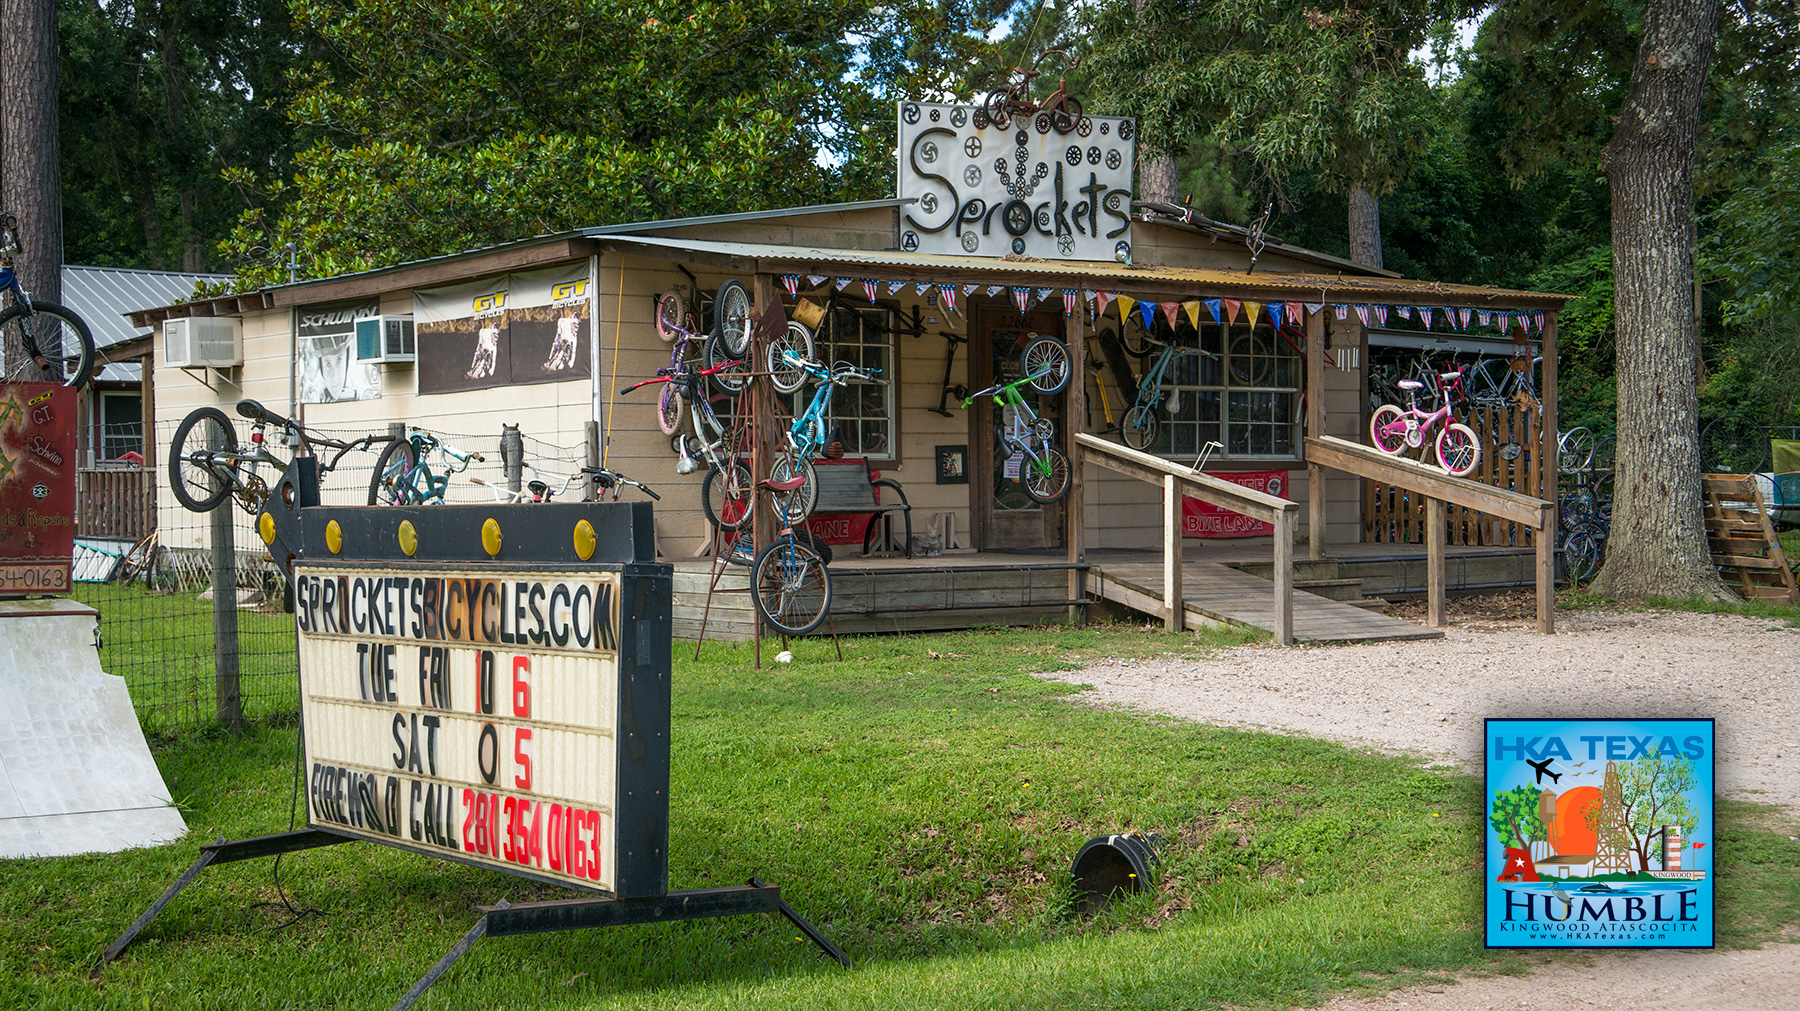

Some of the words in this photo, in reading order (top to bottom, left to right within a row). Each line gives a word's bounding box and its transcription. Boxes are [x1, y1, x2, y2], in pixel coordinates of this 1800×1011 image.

[905, 127, 1132, 239] Sprockets
[472, 289, 508, 313] GT
[551, 277, 590, 301] GT
[300, 306, 377, 328] SCHWINN
[30, 436, 63, 466] Schwinn
[0, 508, 17, 527] ds
[18, 511, 27, 527] &
[27, 508, 70, 532] Repairs
[1187, 515, 1221, 532] BIKE
[1223, 515, 1263, 532] LANE
[297, 575, 617, 650] SPROCKETSBICYCLES.COM
[356, 642, 397, 702] TUE
[419, 646, 450, 709] FRI
[475, 650, 495, 714] 10
[513, 656, 529, 718] 6
[392, 712, 440, 776] SAT
[514, 728, 532, 790] 5
[410, 780, 458, 849] CALL
